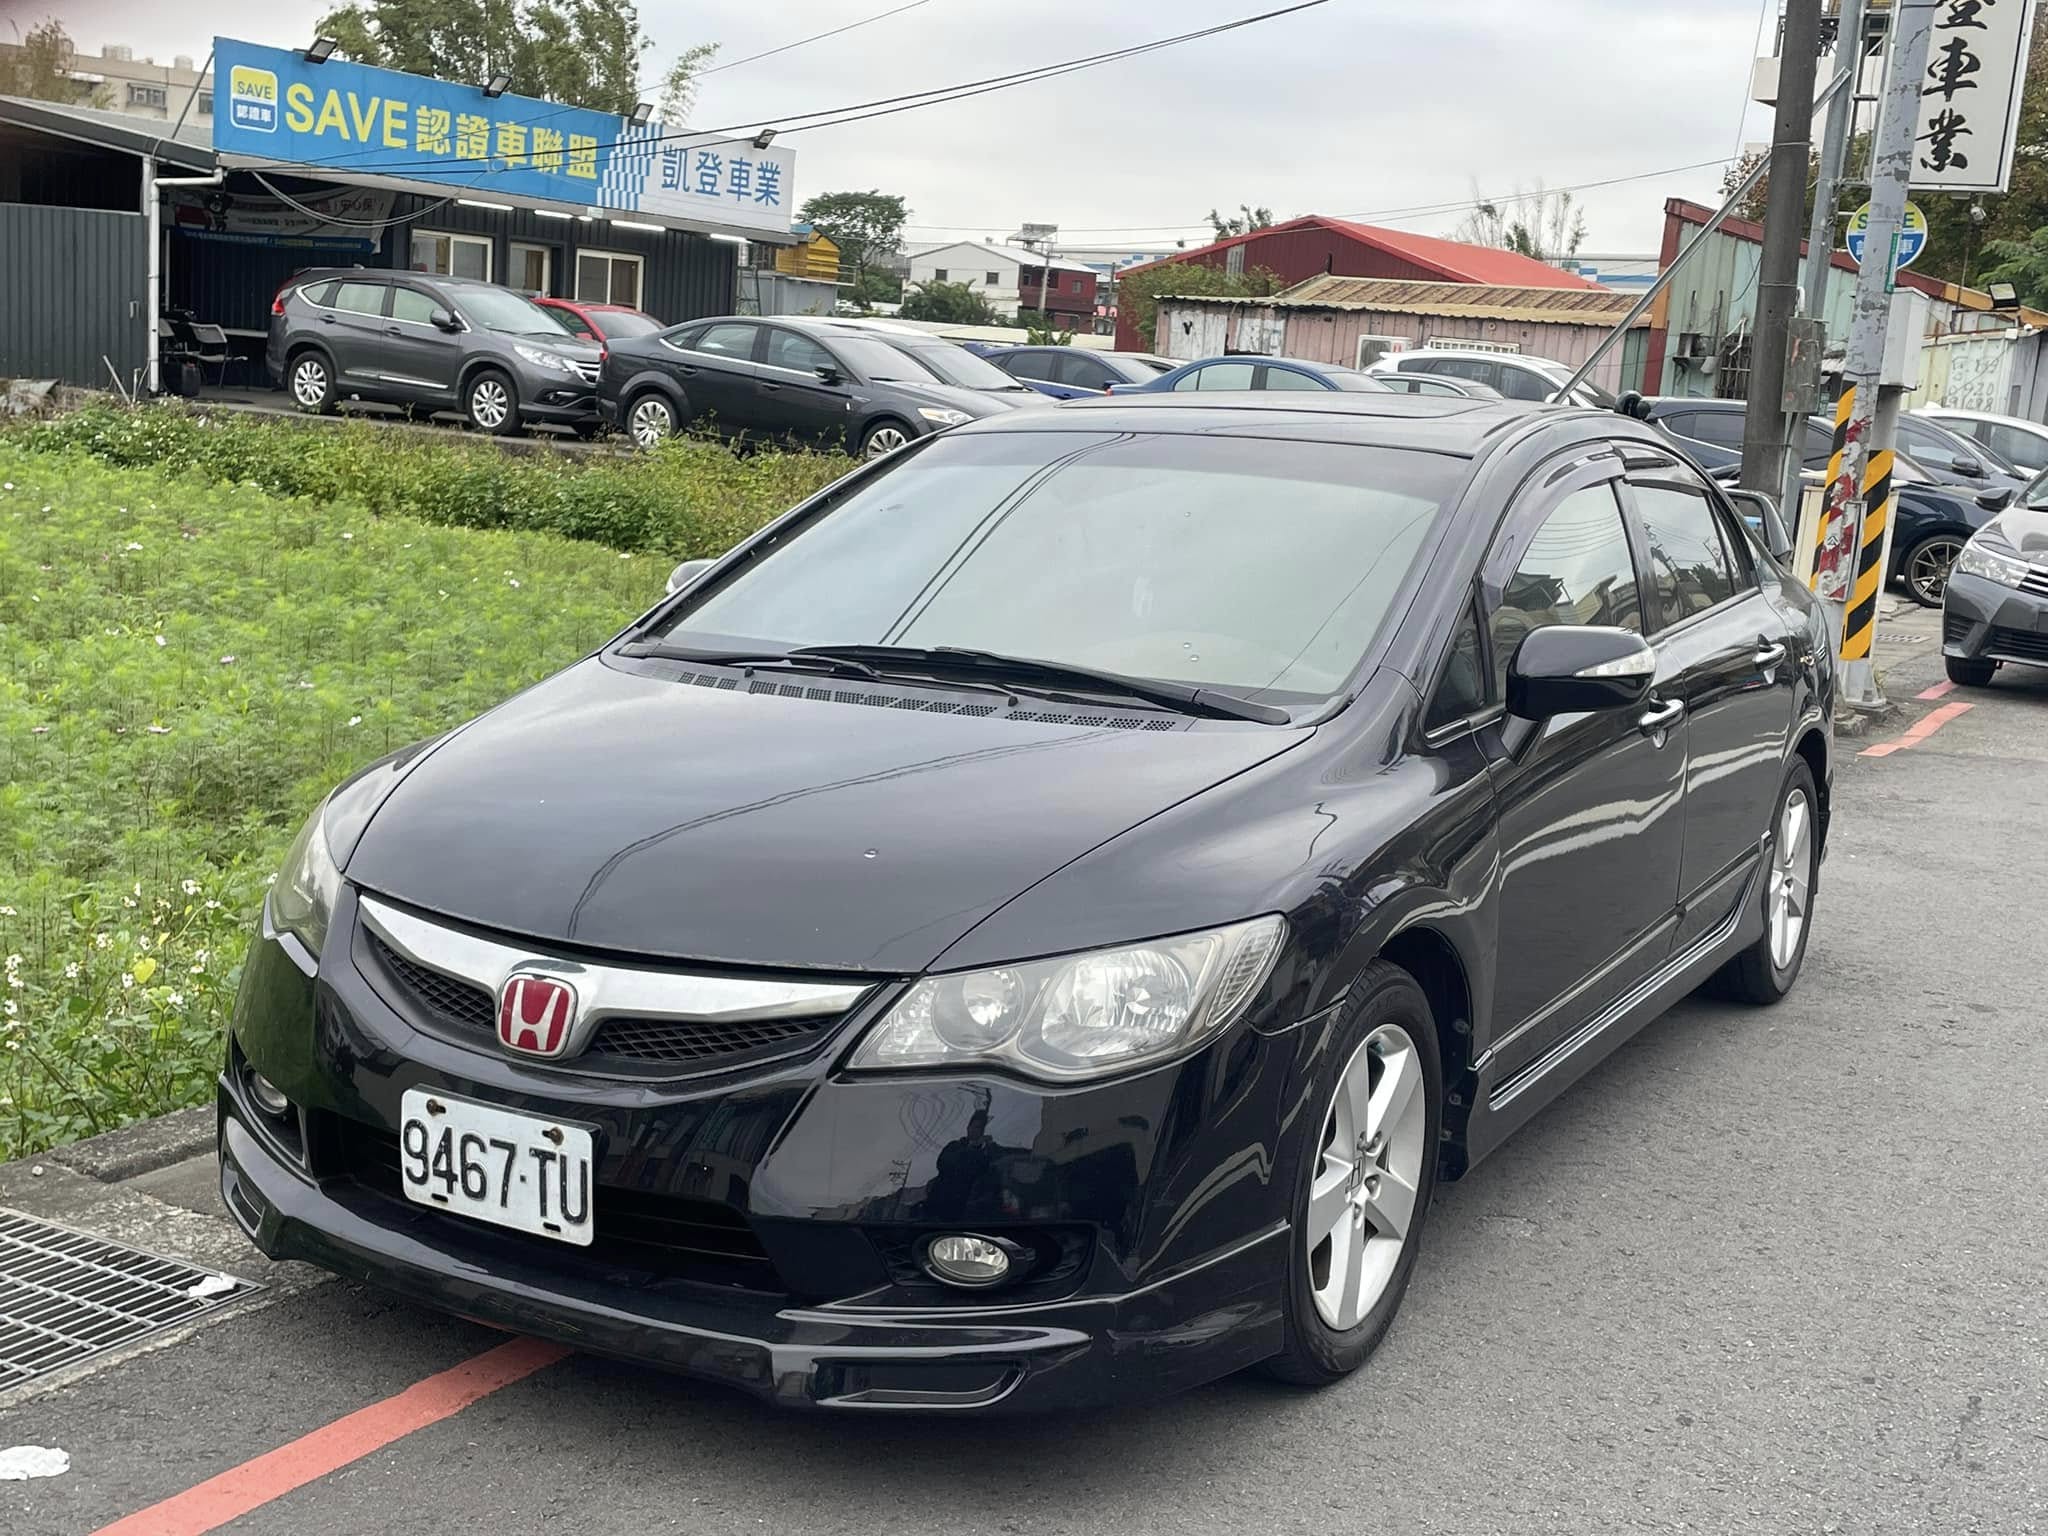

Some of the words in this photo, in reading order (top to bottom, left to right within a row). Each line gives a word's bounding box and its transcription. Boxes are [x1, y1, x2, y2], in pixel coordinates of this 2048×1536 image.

[237, 81, 272, 100] SAVE
[285, 83, 408, 149] SAVE
[416, 105, 598, 179] 認證車聯盟
[661, 144, 781, 206] 凱登車業
[1857, 212, 1915, 230] SE
